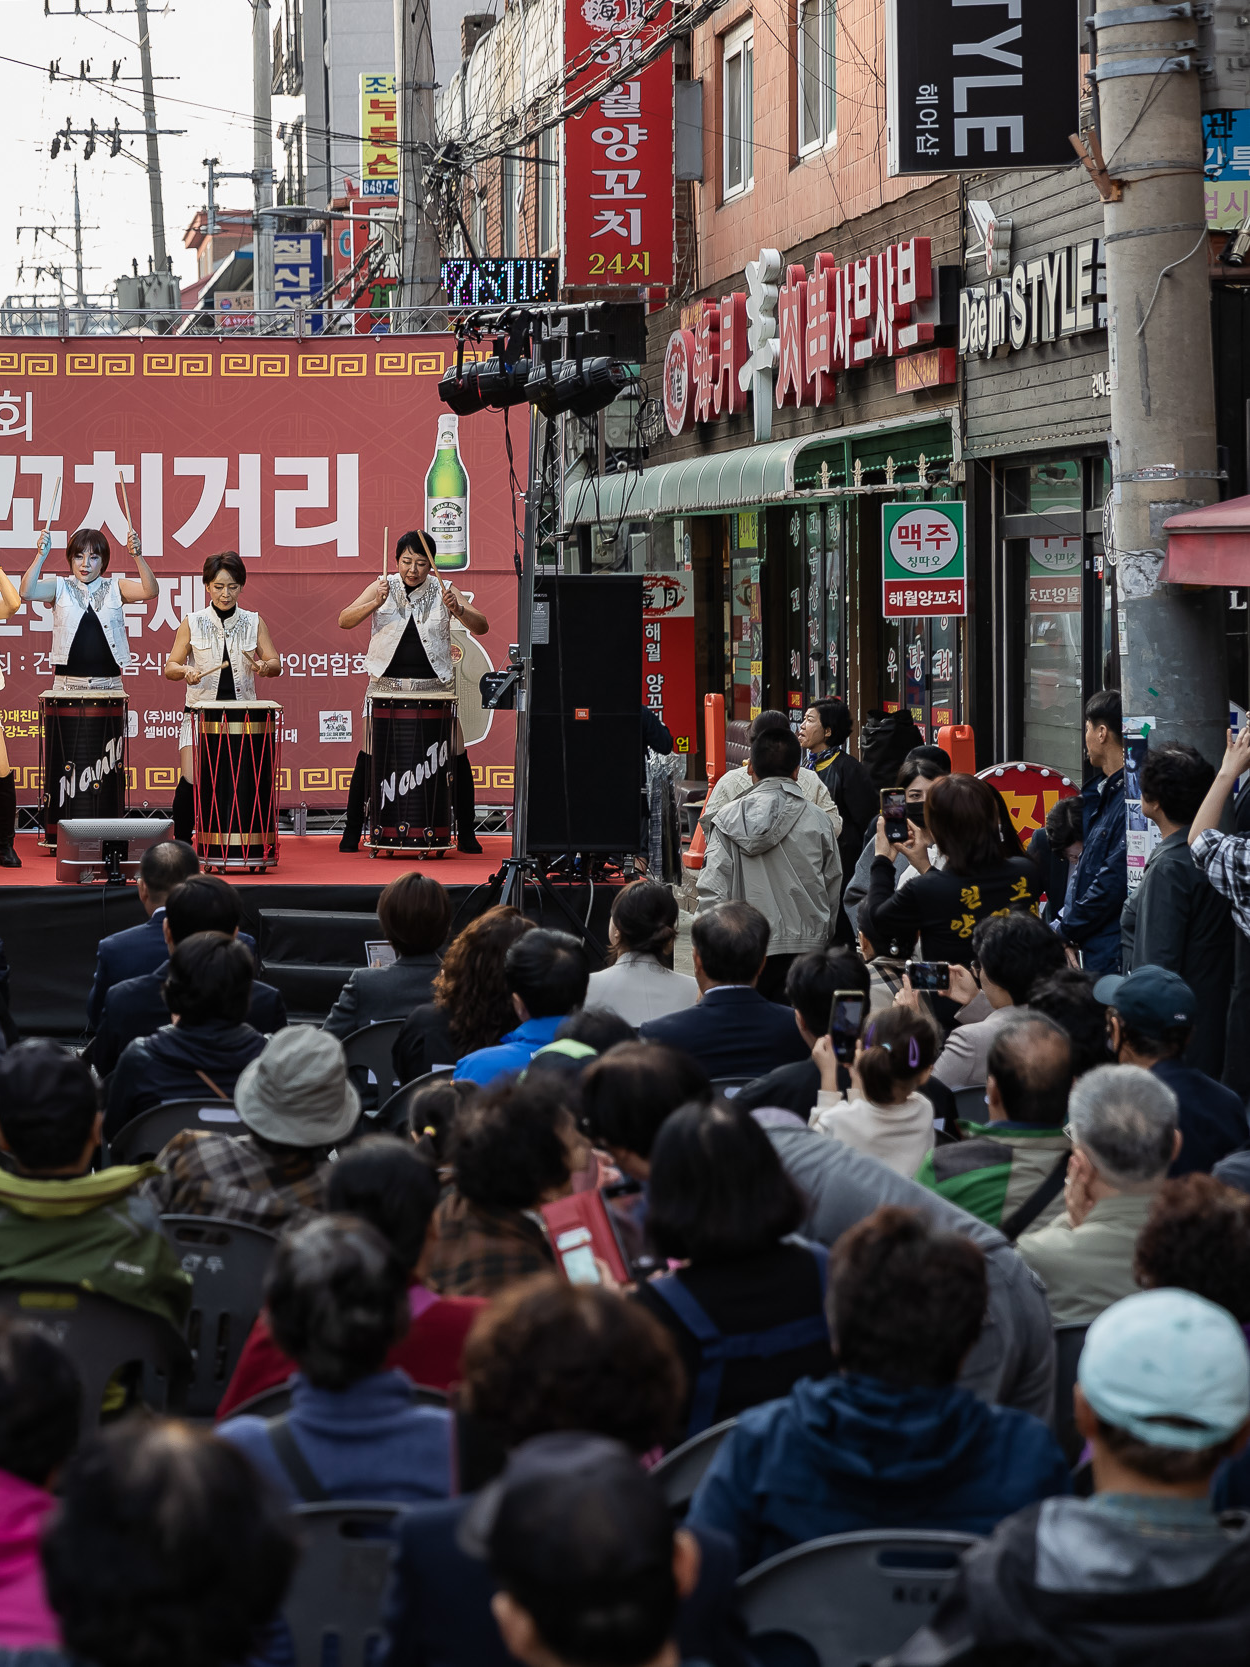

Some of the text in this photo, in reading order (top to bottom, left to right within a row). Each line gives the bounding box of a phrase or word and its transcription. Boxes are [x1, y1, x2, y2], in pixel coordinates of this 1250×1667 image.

[916, 84, 940, 156] 헤어샵
[588, 252, 650, 276] 24시
[833, 237, 918, 370] 샤브샤브
[958, 238, 1099, 360] Daejin STYLE
[897, 523, 951, 551] 맥주
[907, 555, 942, 568] 칭따오
[888, 589, 962, 607] 해월양꼬치
[645, 622, 661, 662] 해월
